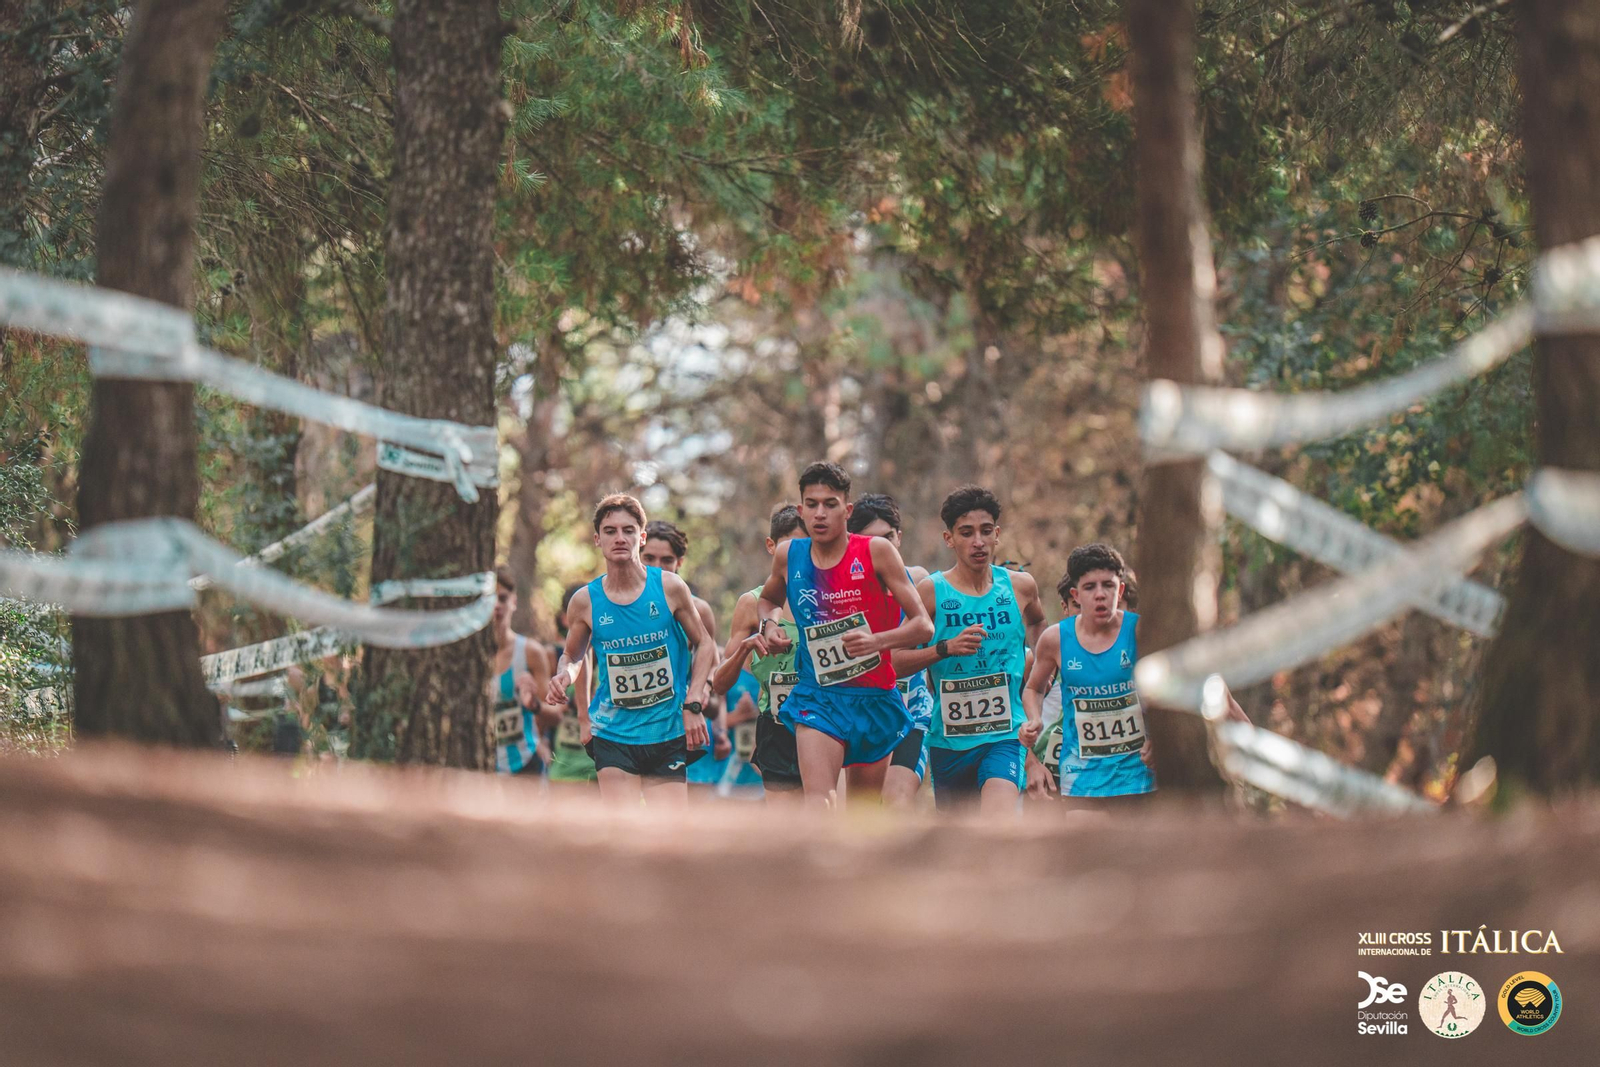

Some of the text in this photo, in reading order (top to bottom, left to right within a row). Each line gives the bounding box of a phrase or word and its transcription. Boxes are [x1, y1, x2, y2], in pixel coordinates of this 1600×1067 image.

[821, 588, 862, 603] lapalma
[945, 607, 1011, 631] nerja
[601, 629, 669, 650] TROTASIERRA
[615, 667, 669, 693] 8128
[1067, 679, 1136, 695] TROTASIERR
[948, 696, 1006, 721] 8123
[1082, 715, 1140, 741] 8141
